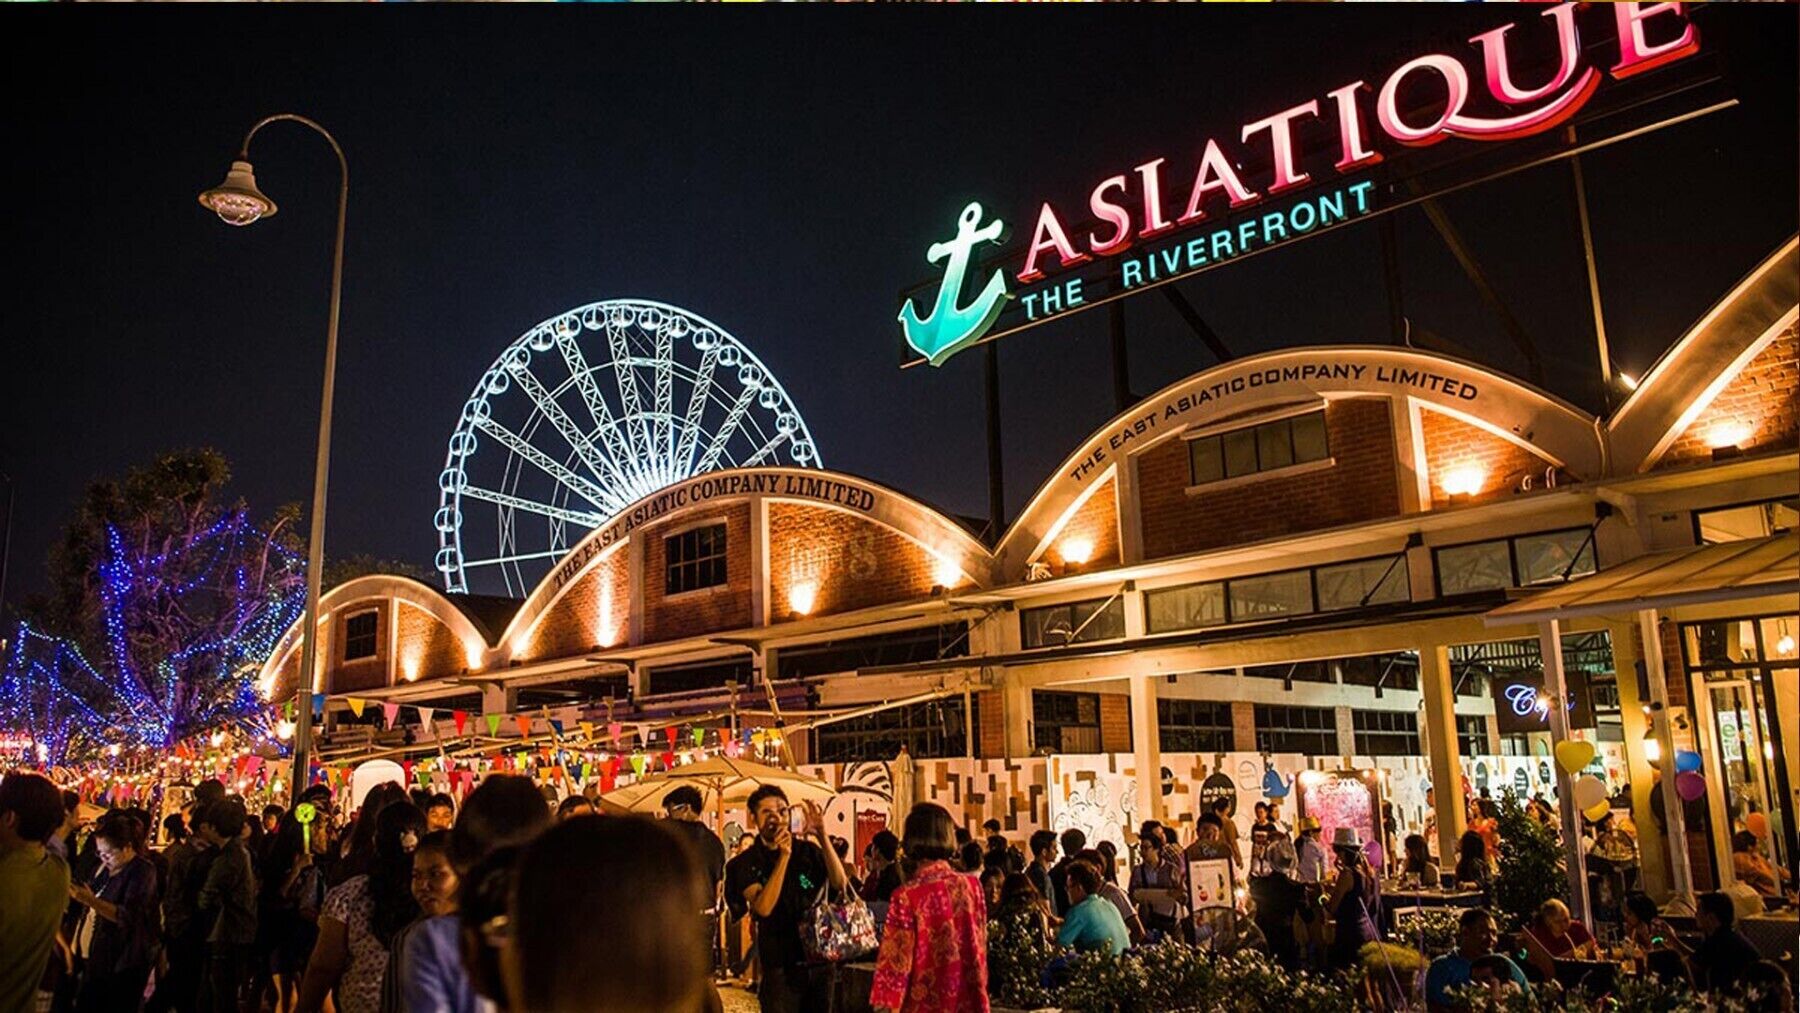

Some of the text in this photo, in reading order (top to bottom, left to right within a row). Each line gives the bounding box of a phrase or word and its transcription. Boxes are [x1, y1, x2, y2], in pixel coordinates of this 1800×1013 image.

[1016, 2, 1698, 280] ASIATIQUE
[1021, 181, 1373, 321] THE RIVERFRONT
[1070, 364, 1479, 481] THE EAST ASIATIC COMPANY LIMITED
[554, 475, 875, 588] THE EAST ASIATIC COMPANY LIMITED
